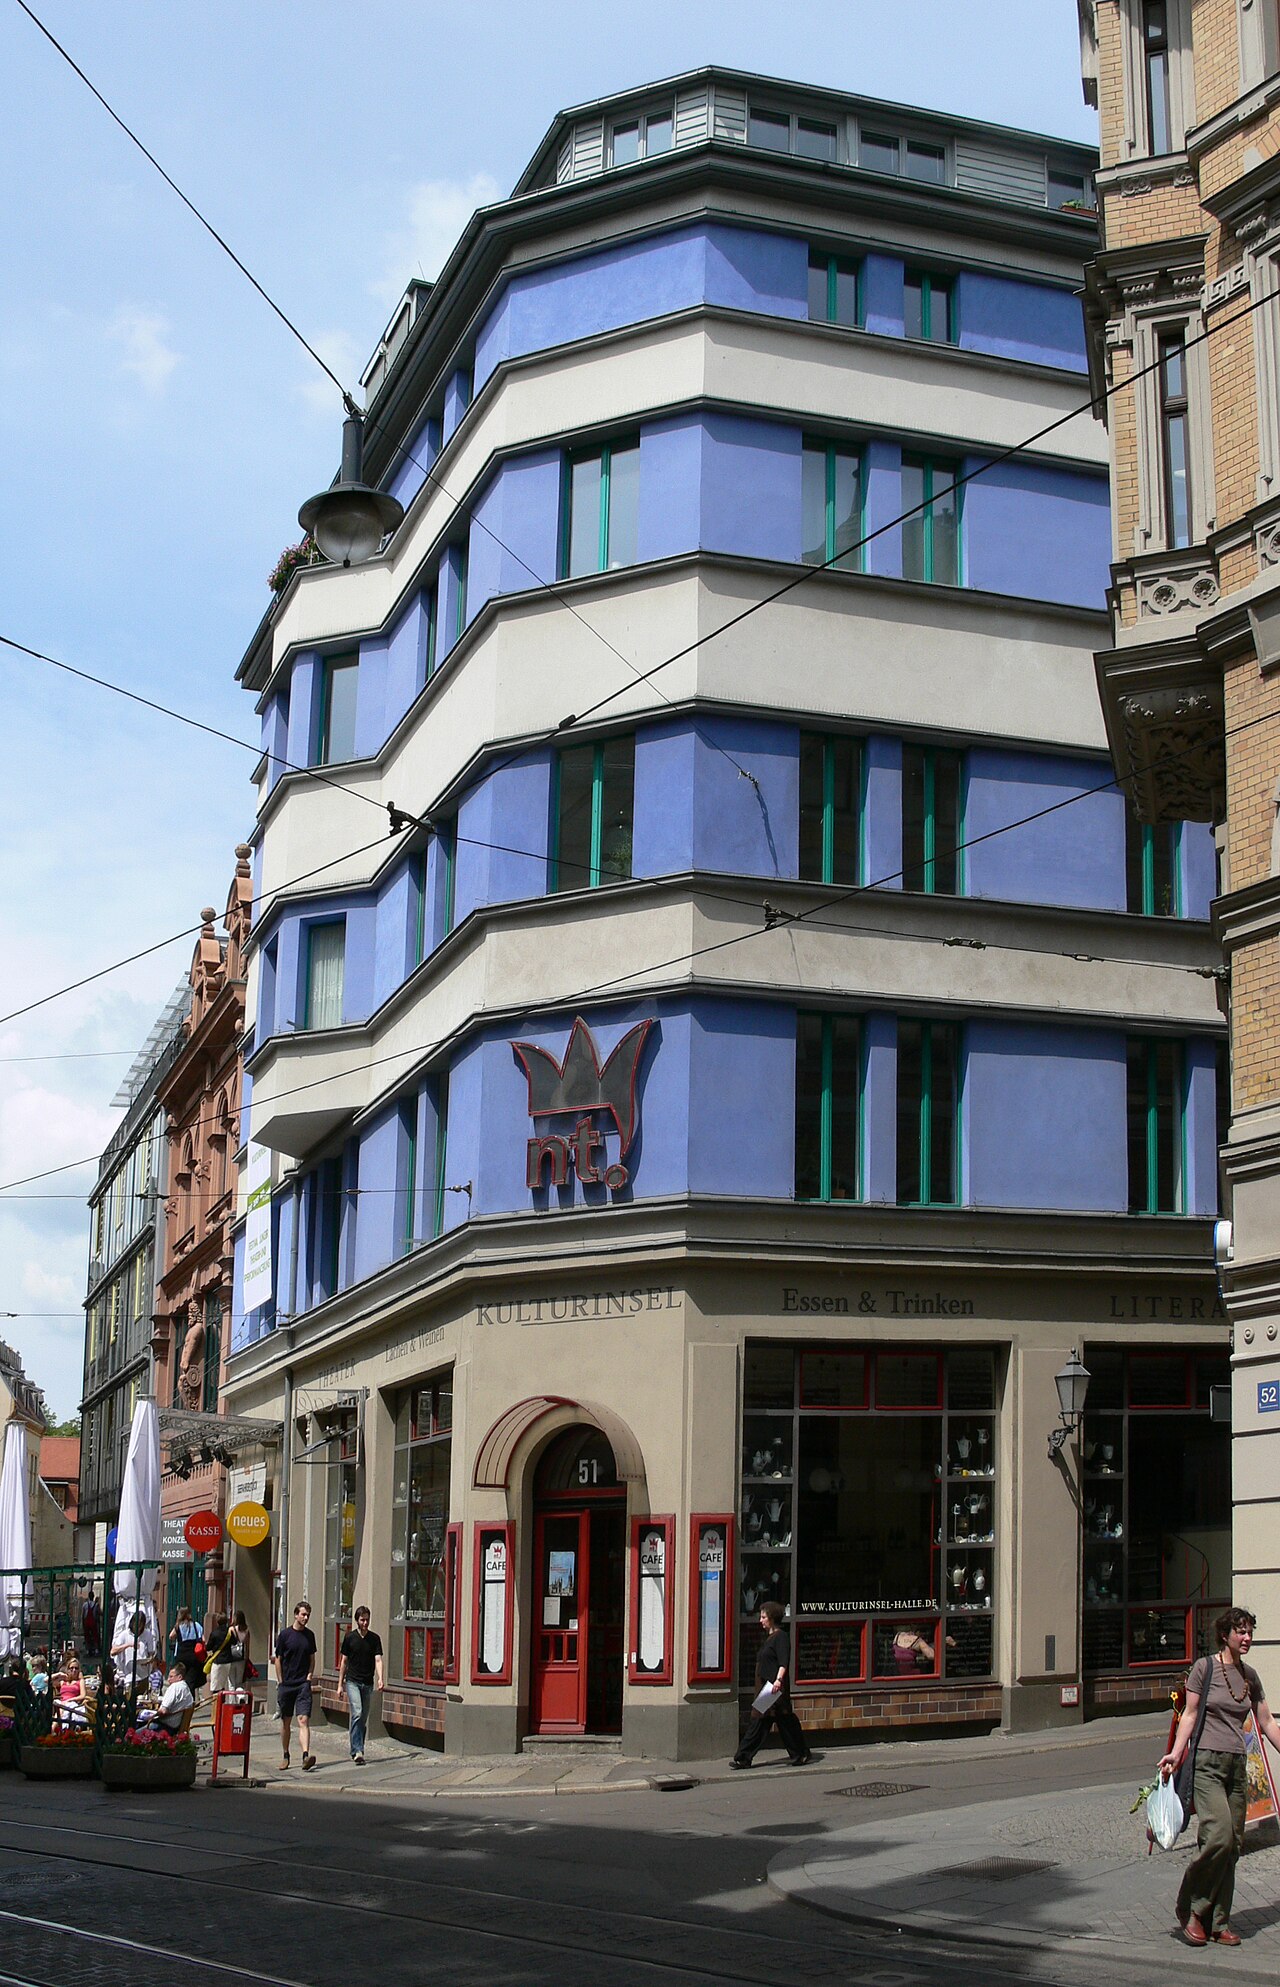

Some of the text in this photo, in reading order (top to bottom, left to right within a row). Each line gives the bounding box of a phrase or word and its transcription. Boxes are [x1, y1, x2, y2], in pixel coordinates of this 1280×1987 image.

[476, 1286, 683, 1326] KULTURINSEL
[782, 1288, 975, 1315] Essen & Trinken
[318, 1357, 356, 1389] THEATER
[1260, 1386, 1277, 1403] 52
[578, 1458, 598, 1484] 51
[233, 1515, 266, 1527] neues
[188, 1526, 220, 1536] KASSE
[162, 1550, 185, 1558] KASSE
[641, 1553, 664, 1565] CAFÉ
[699, 1551, 723, 1563] CAFÉ
[801, 1598, 937, 1612] WWW.KULTURINSEL-HALLE.DE
